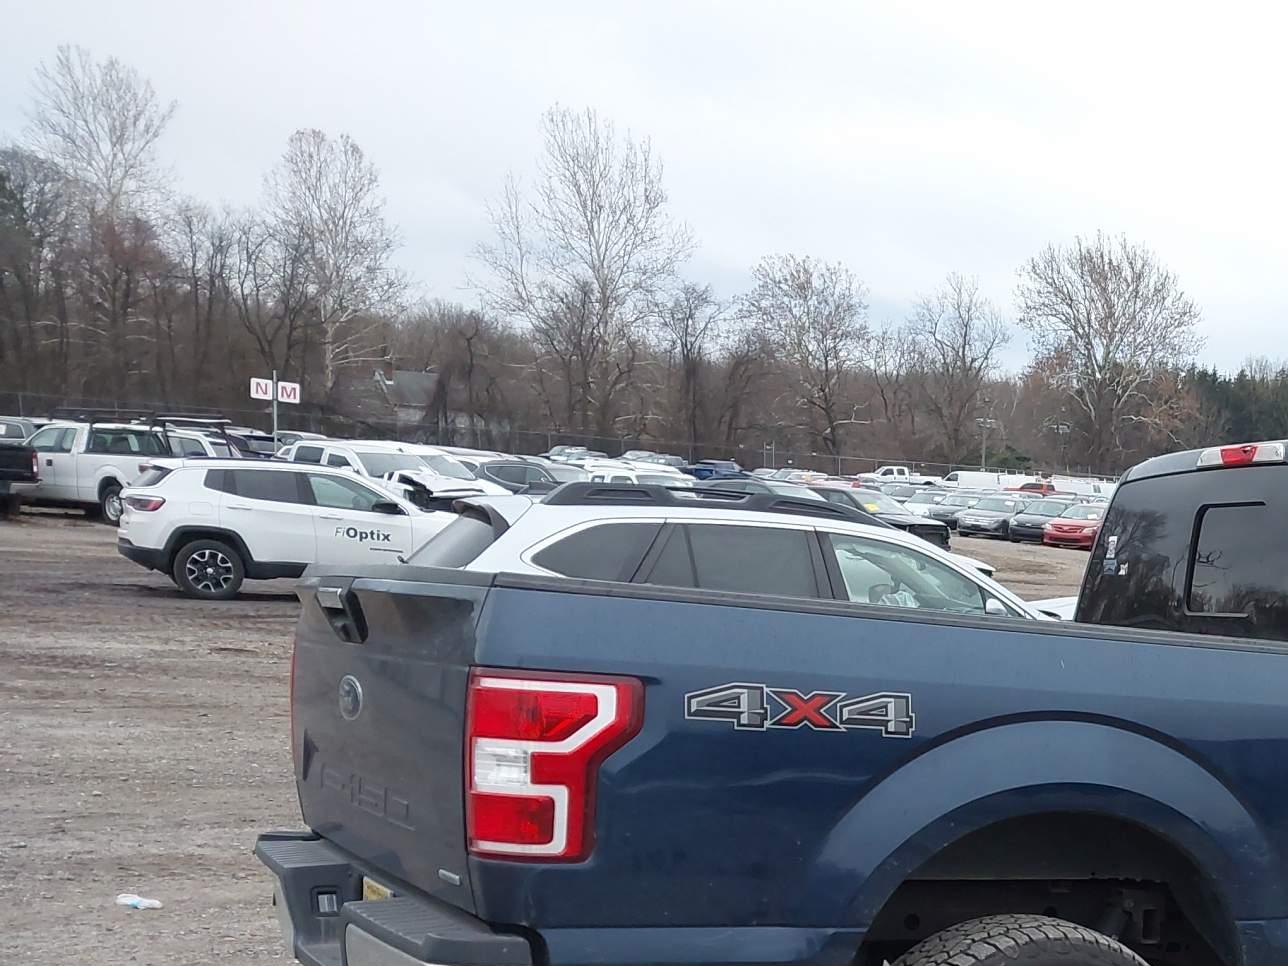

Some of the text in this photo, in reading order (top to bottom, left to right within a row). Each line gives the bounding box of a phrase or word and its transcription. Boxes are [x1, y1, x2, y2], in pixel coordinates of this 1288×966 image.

[255, 381, 268, 396] N
[281, 385, 297, 400] M
[335, 526, 391, 542] FiOptix
